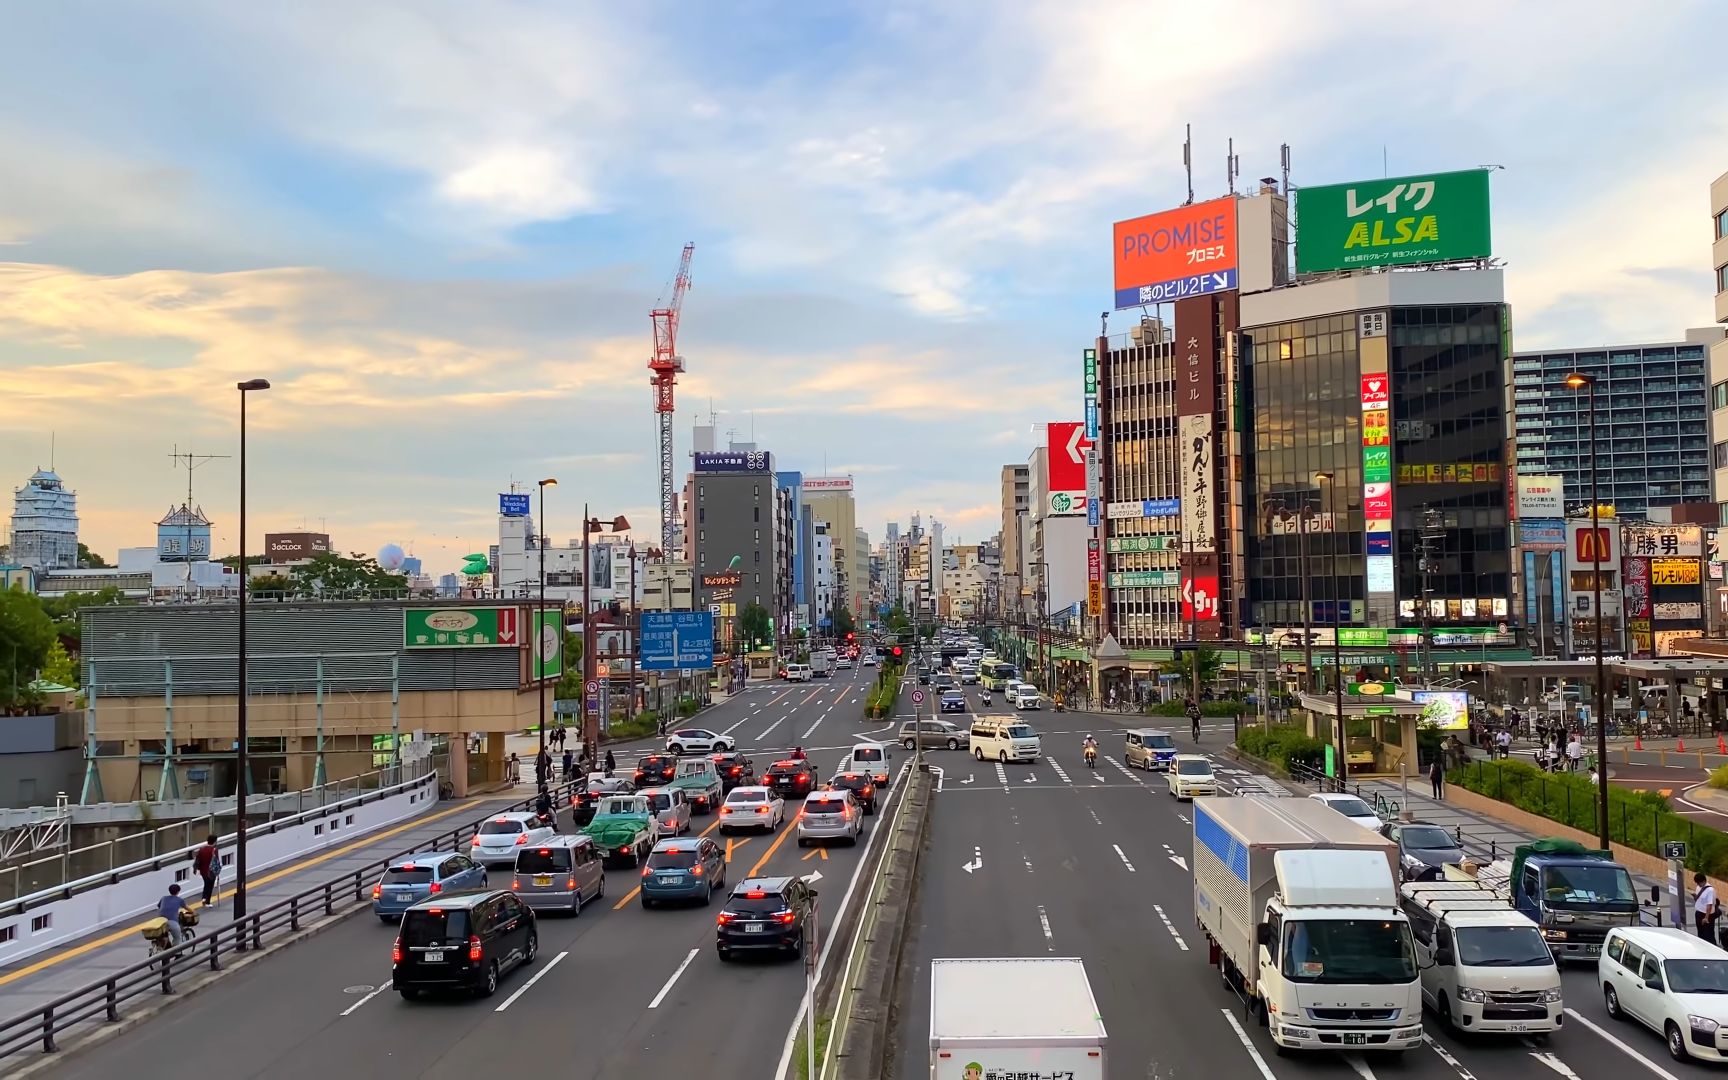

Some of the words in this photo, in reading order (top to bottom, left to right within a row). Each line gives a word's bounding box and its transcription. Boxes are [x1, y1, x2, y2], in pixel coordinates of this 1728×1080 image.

[1346, 181, 1435, 217] レイク
[1124, 215, 1225, 261] PROMISE
[1344, 215, 1439, 249] ALSA
[1186, 245, 1225, 265] プロミス
[1139, 274, 1210, 303] 隣のビル2F
[1187, 336, 1200, 402] 大信ビル
[1363, 391, 1387, 401] アイフル
[1366, 452, 1387, 460] レイク
[1287, 520, 1334, 531] アフル
[1636, 534, 1680, 555] 勝男
[1090, 584, 1100, 615] 処方せん
[1183, 579, 1218, 617] くすり
[678, 614, 694, 623] 谷町
[1672, 848, 1679, 857] 5
